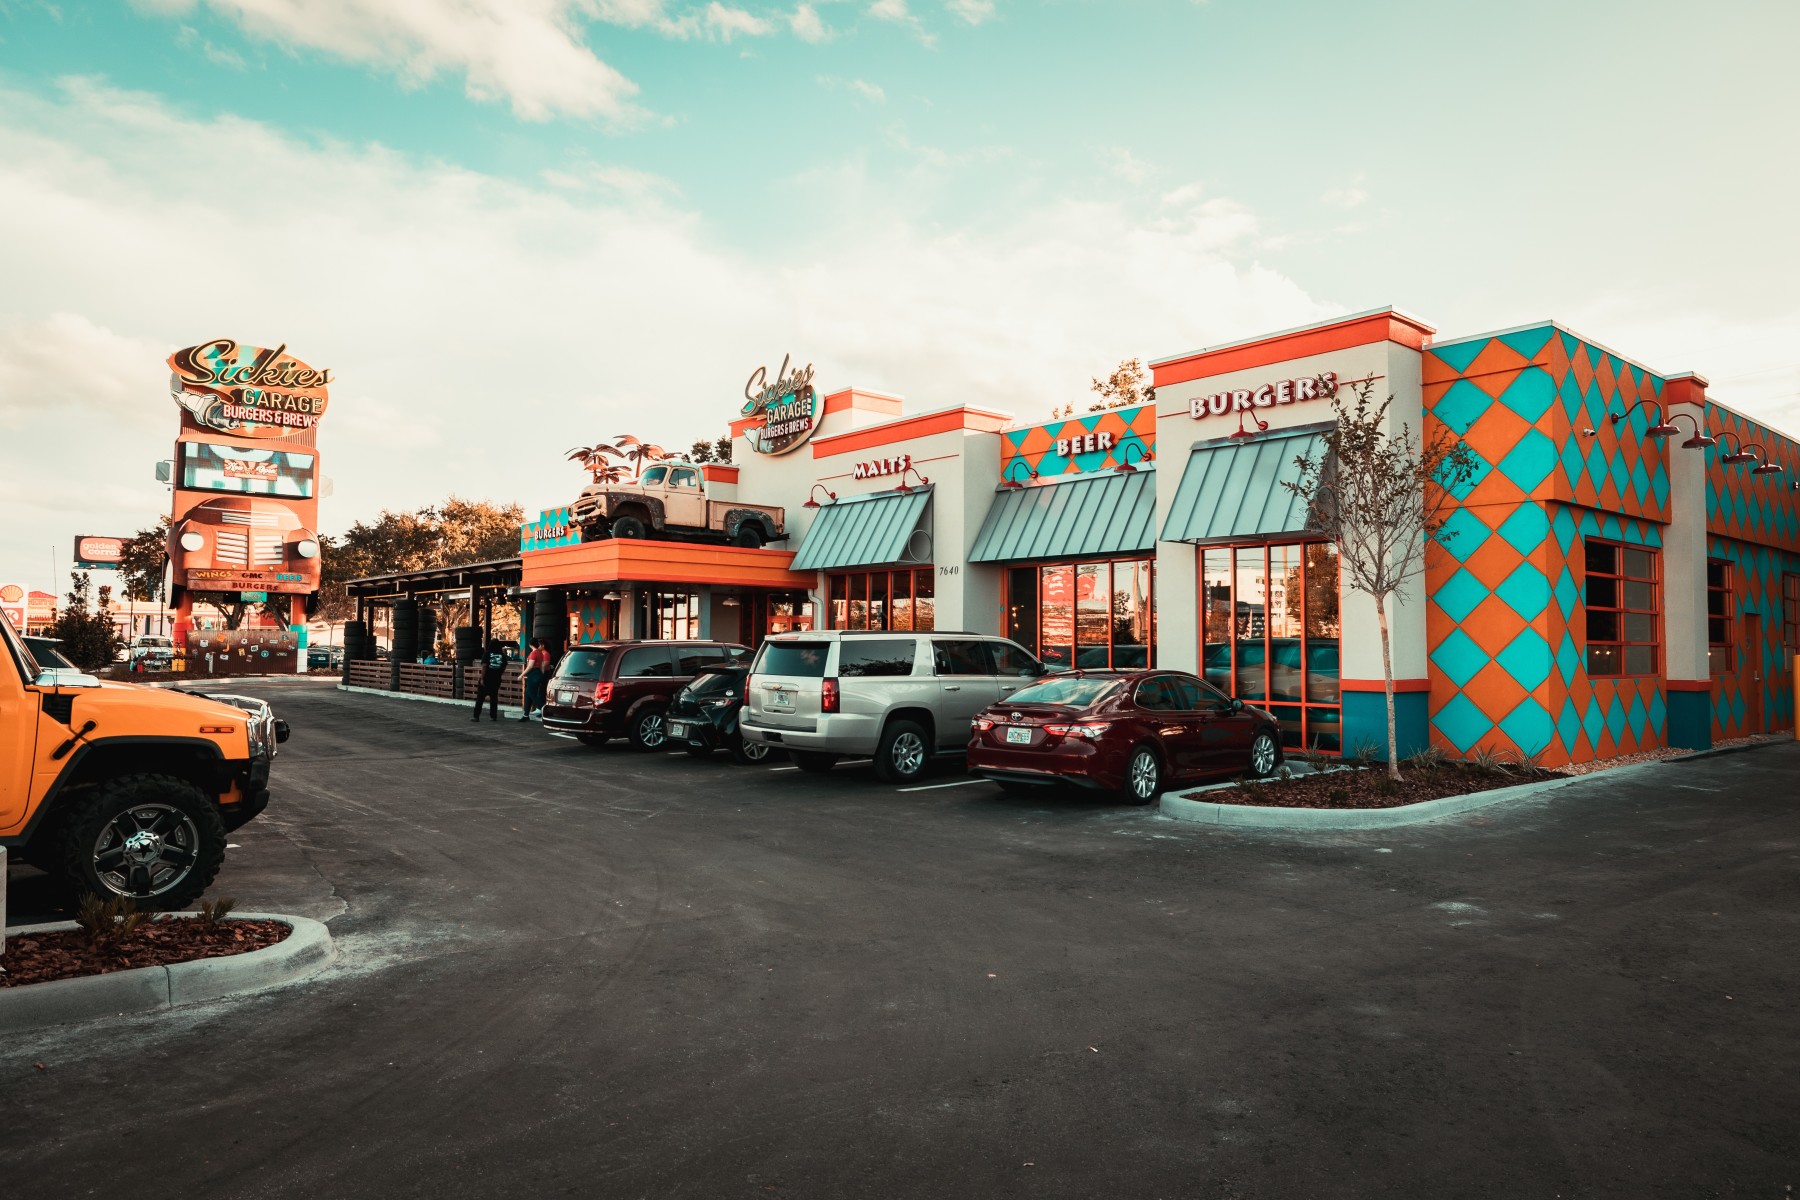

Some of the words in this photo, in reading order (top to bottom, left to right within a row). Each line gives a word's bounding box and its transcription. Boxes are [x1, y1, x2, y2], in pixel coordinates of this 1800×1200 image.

[180, 338, 335, 386] Sickies
[740, 353, 814, 417] Sickies
[1189, 371, 1336, 419] BURGERS
[243, 388, 323, 414] GARAGE
[767, 399, 807, 424] GARAGE
[223, 404, 273, 423] BURGERS
[275, 411, 282, 423] &
[283, 412, 320, 428] BREWS
[760, 424, 784, 440] BURGERS
[789, 417, 808, 433] BREWS
[1056, 431, 1113, 457] BEER
[852, 455, 909, 479] MALTS
[534, 525, 565, 540] BURGERS
[82, 542, 117, 550] golden
[276, 573, 302, 581] BEER
[939, 566, 959, 576] 7640
[232, 582, 279, 591] BURGERS
